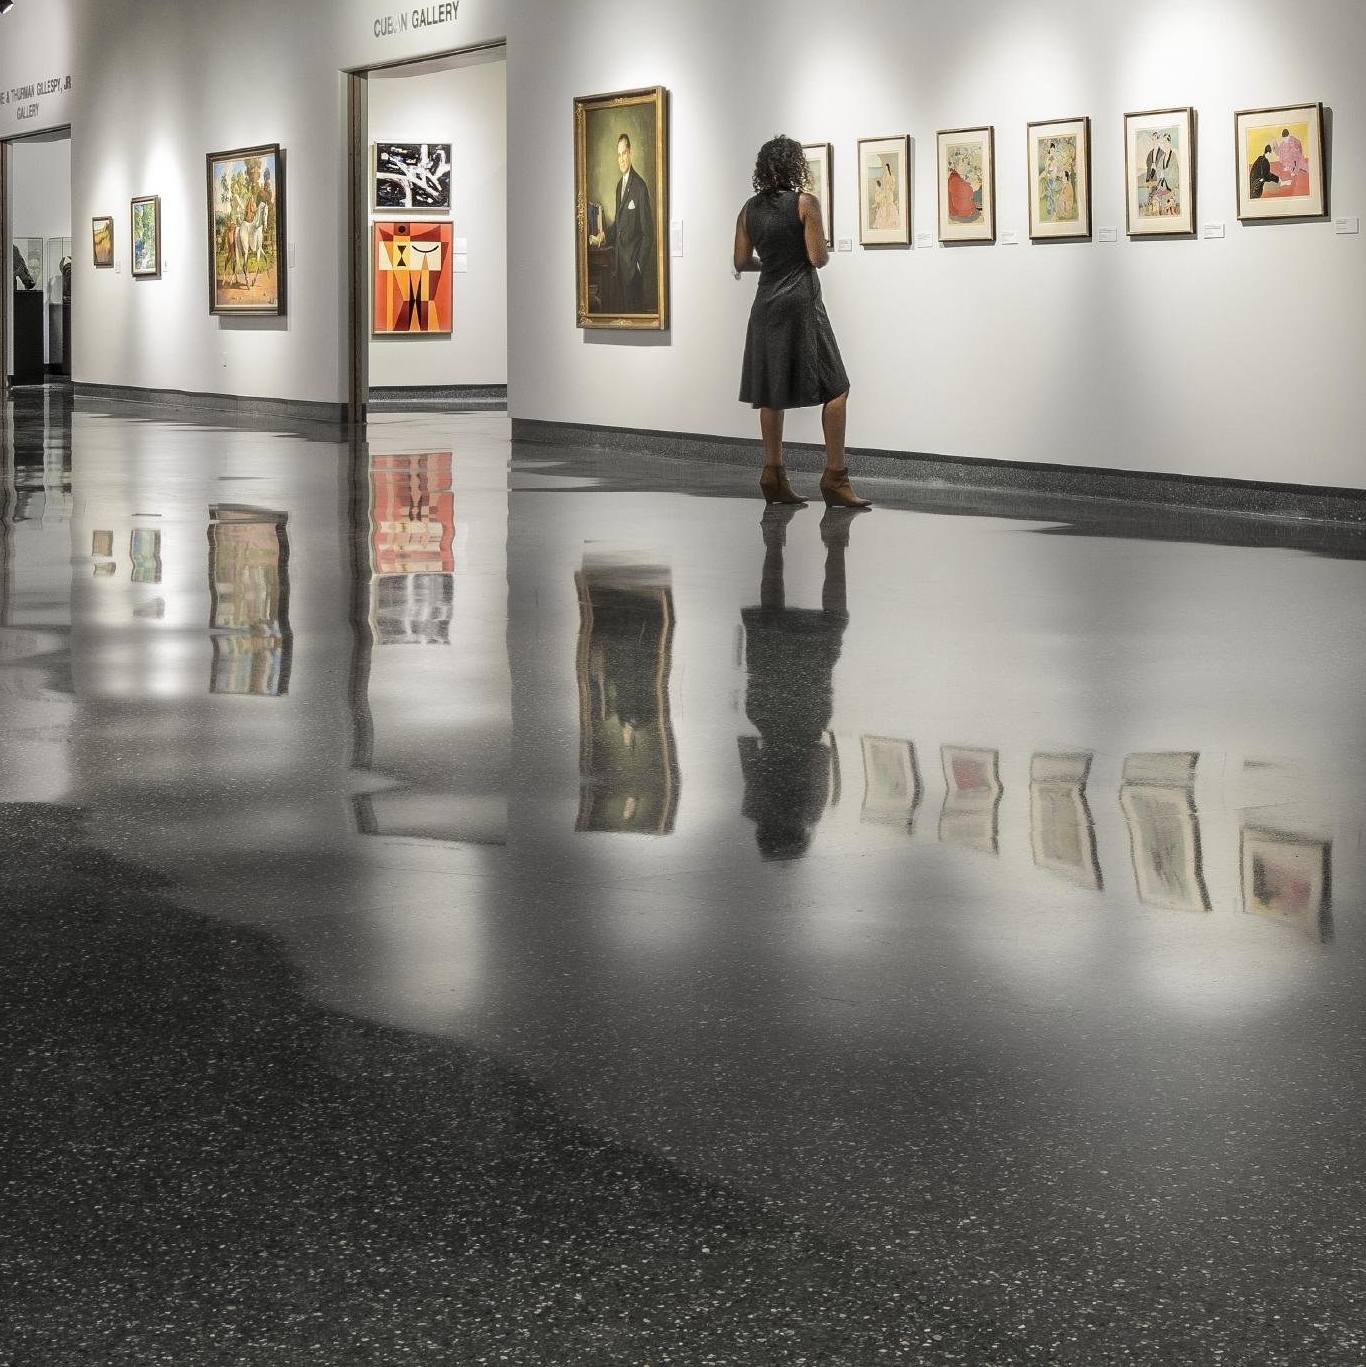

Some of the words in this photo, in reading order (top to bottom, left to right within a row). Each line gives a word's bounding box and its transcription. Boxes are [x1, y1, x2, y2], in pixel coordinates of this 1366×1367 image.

[411, 0, 459, 28] GALLERY
[37, 78, 63, 95] GILLESPY,
[16, 103, 39, 120] GALLERY
